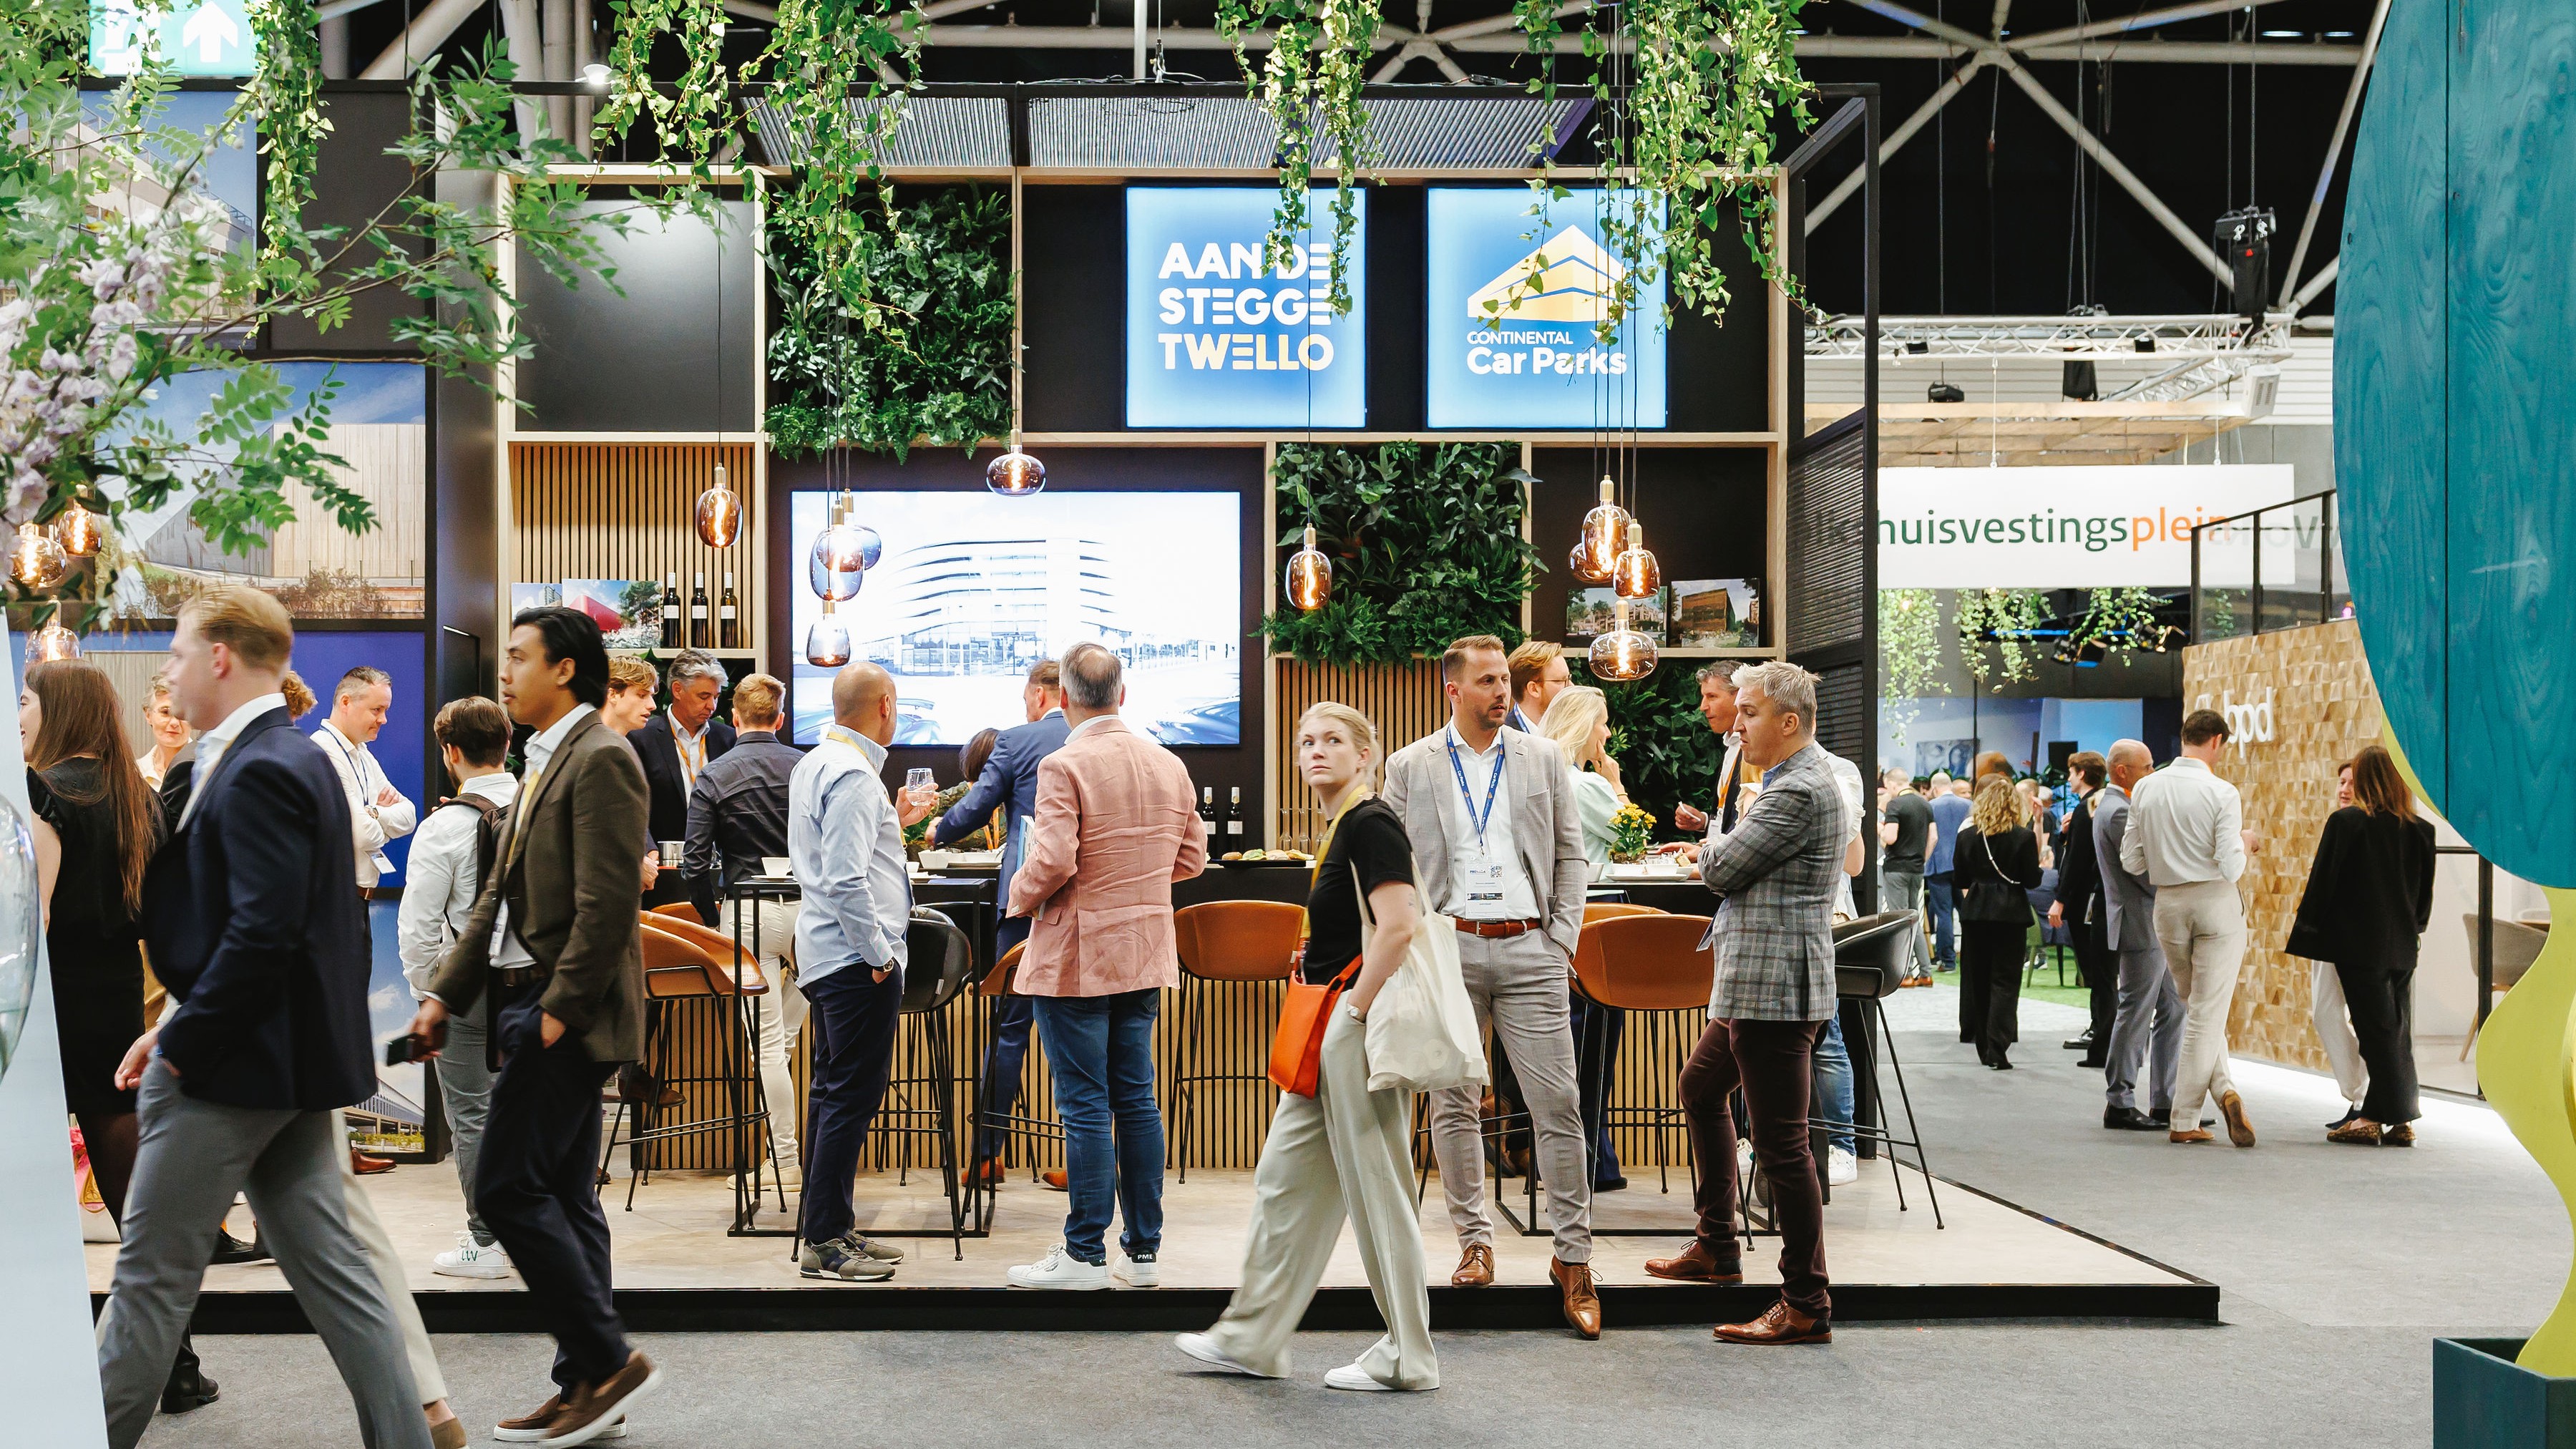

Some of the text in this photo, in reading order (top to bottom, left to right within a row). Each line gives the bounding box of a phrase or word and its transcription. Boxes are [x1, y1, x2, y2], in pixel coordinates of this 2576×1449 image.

[1158, 243, 1331, 280] AAN DE
[1158, 288, 1332, 326] STEGGE
[1158, 333, 1335, 371] TWELLO
[1467, 331, 1574, 345] CONTINENTAL
[1467, 346, 1627, 374] Car Parks
[2223, 686, 2273, 758] bpd
